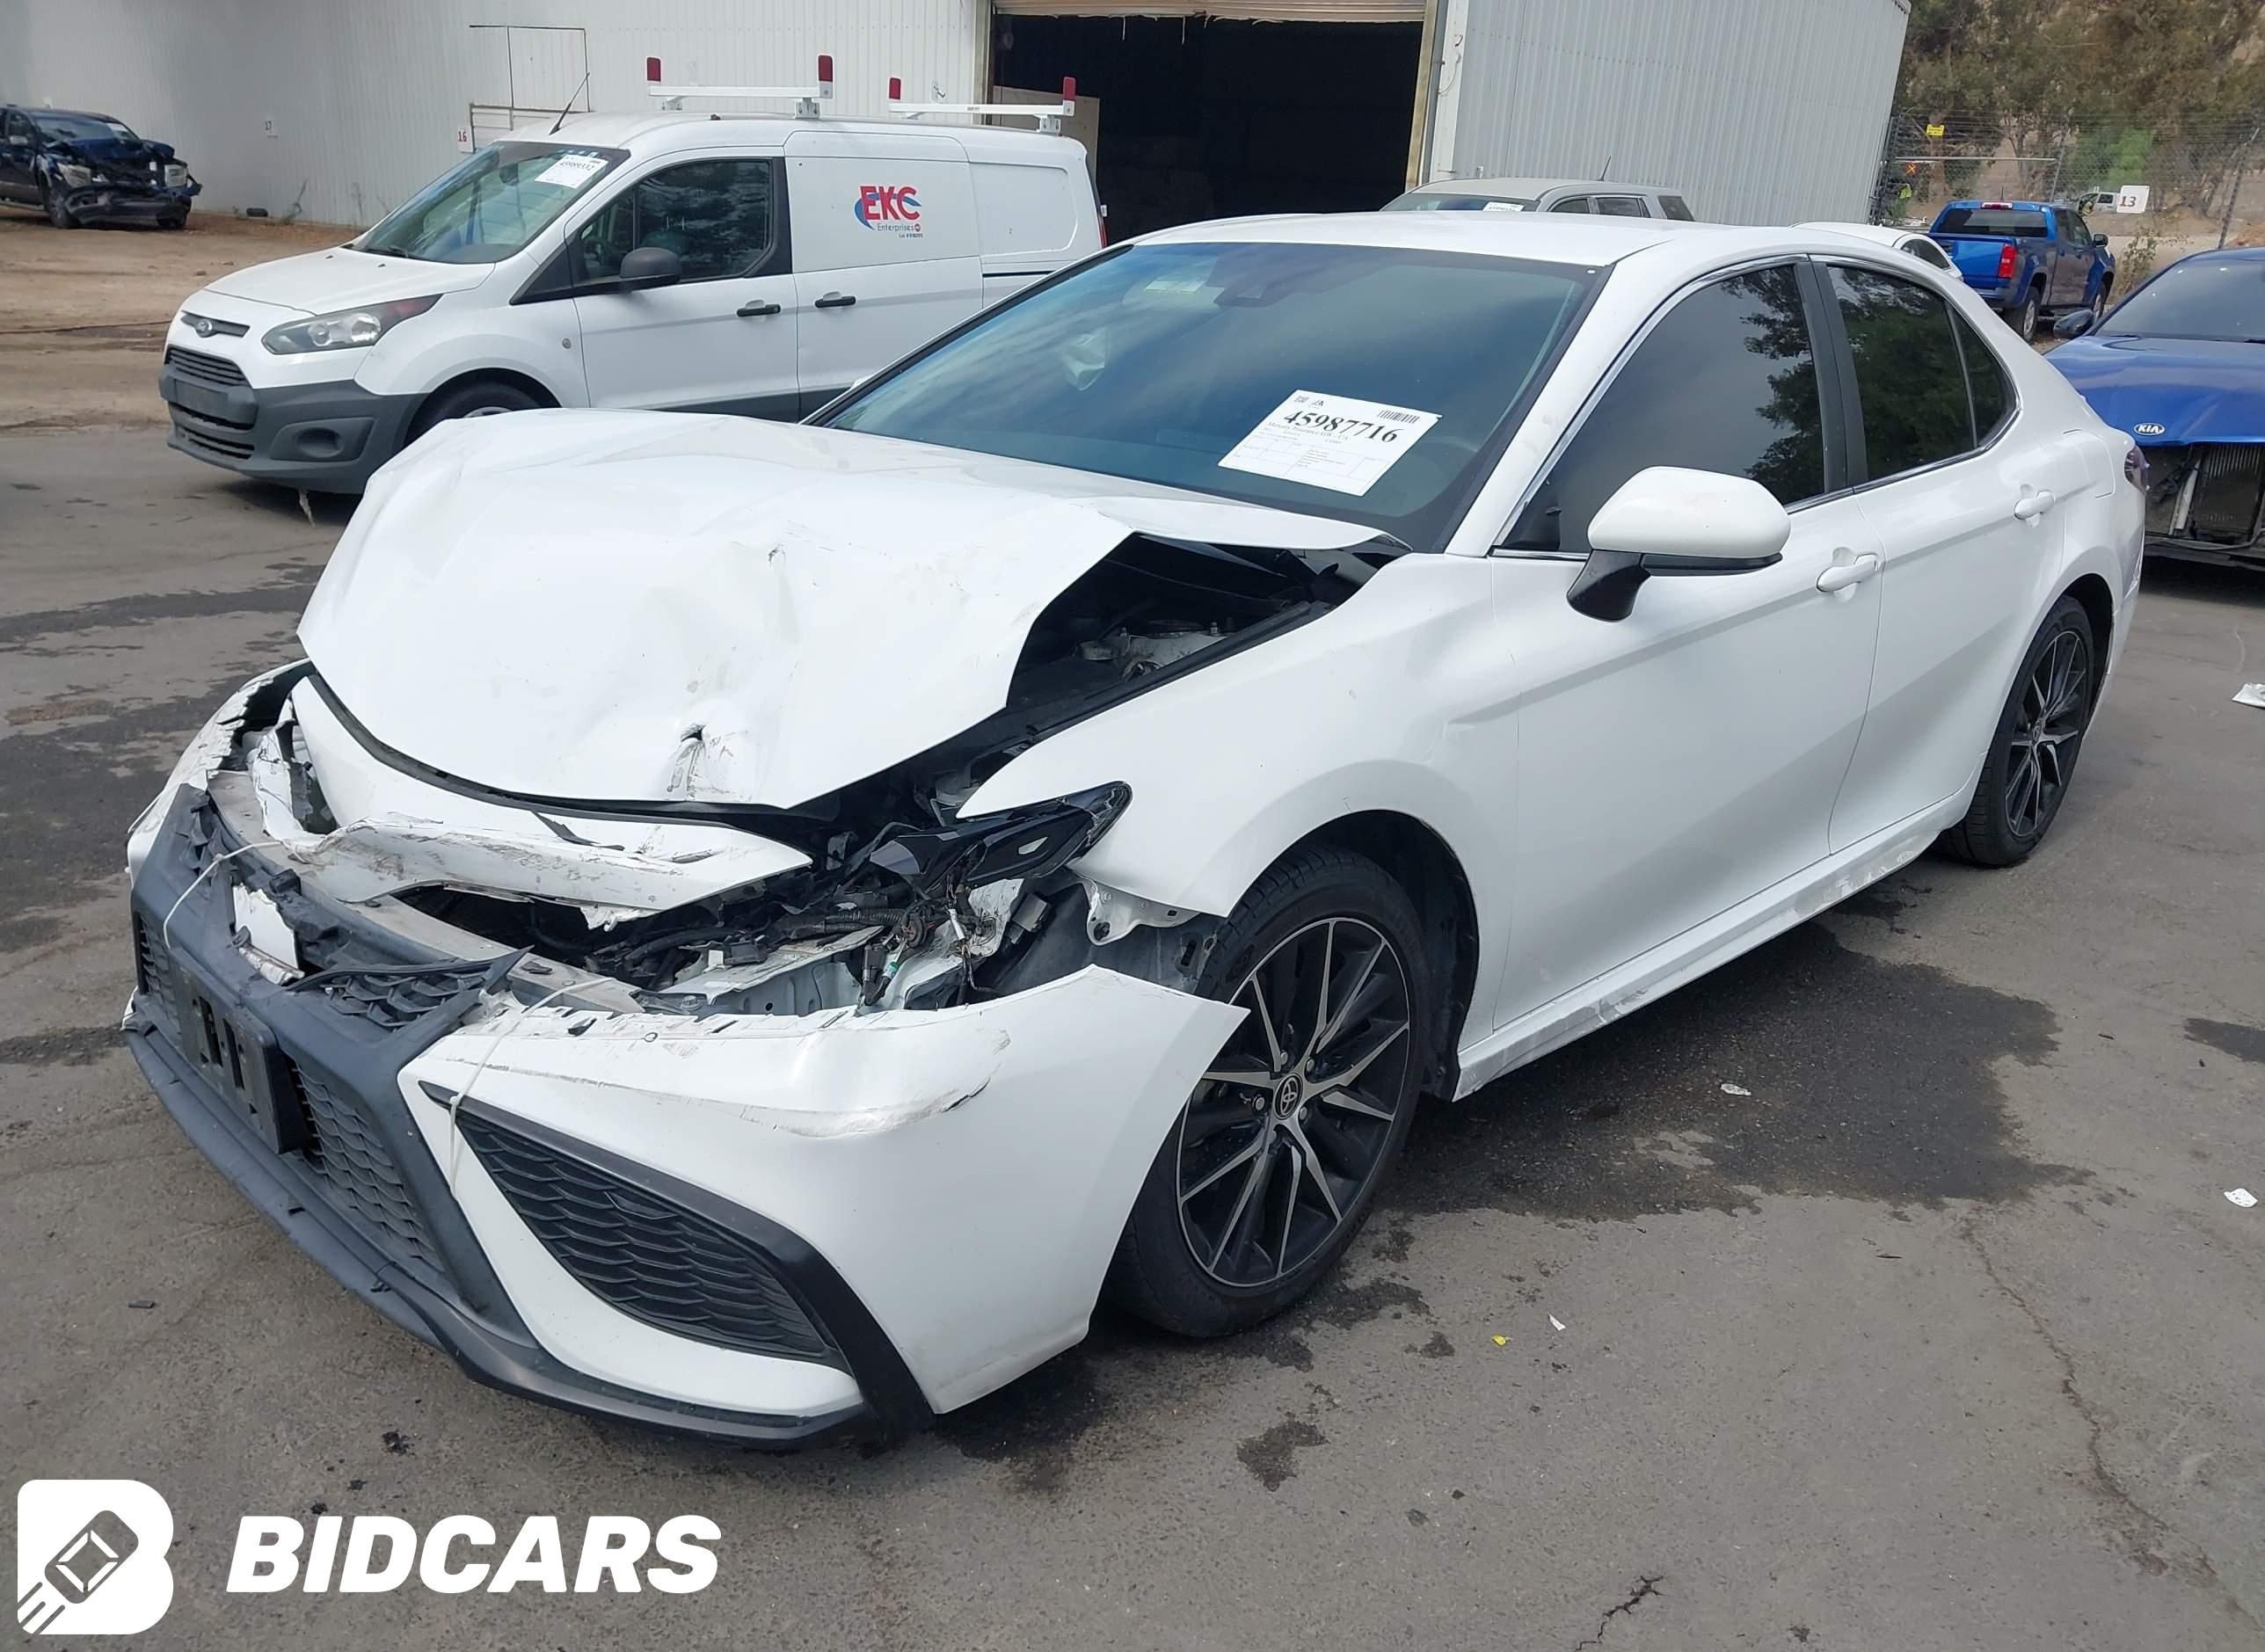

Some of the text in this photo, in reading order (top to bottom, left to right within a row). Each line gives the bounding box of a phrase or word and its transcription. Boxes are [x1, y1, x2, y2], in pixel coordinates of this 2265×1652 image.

[458, 131, 468, 142] 16
[860, 186, 921, 221] EKC
[2119, 196, 2137, 207] 13
[878, 223, 914, 232] Enterprises
[1284, 410, 1405, 443] 45987716
[2138, 425, 2160, 433] KIA
